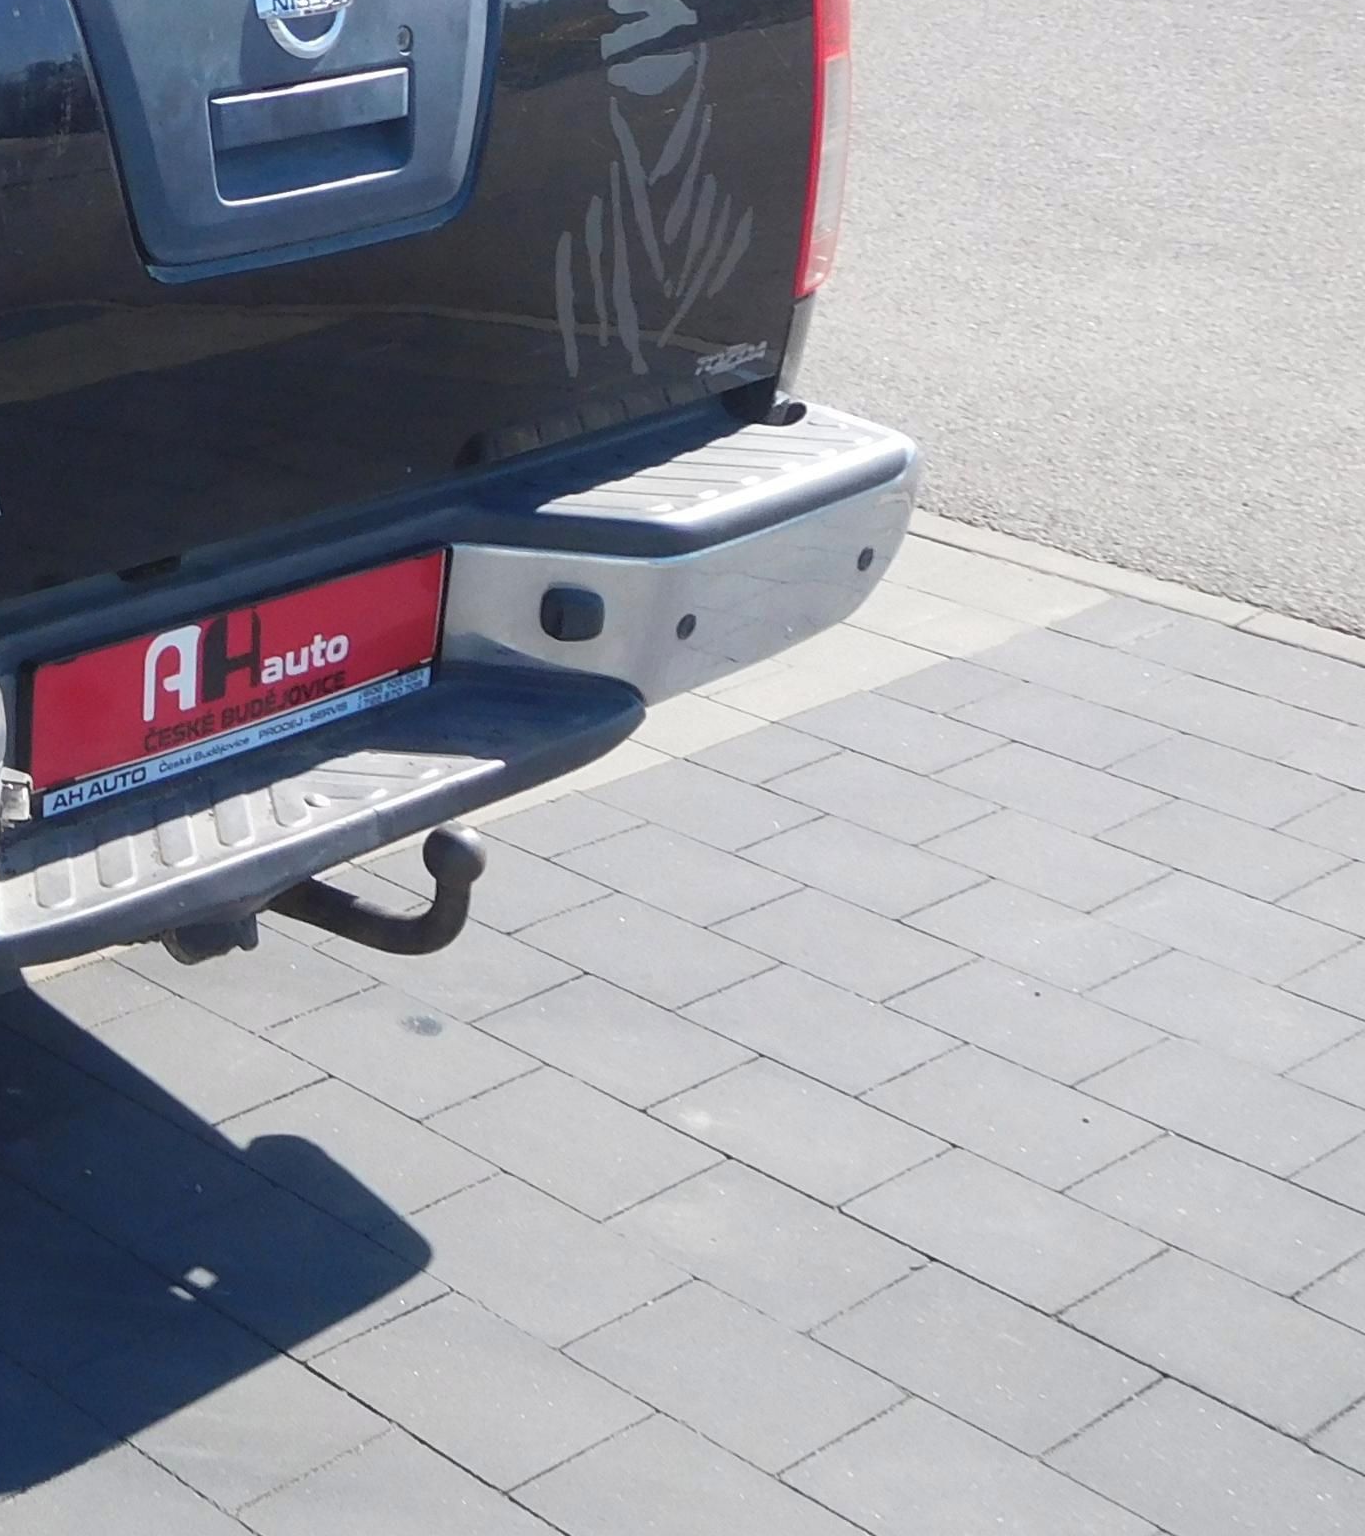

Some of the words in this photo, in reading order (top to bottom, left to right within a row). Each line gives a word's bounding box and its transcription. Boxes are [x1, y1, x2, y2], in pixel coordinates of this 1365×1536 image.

[144, 709, 215, 753] ČESKÉ
[221, 670, 347, 728] BUDĚJOVICE
[53, 788, 84, 811] AH
[88, 766, 147, 800] AUTO
